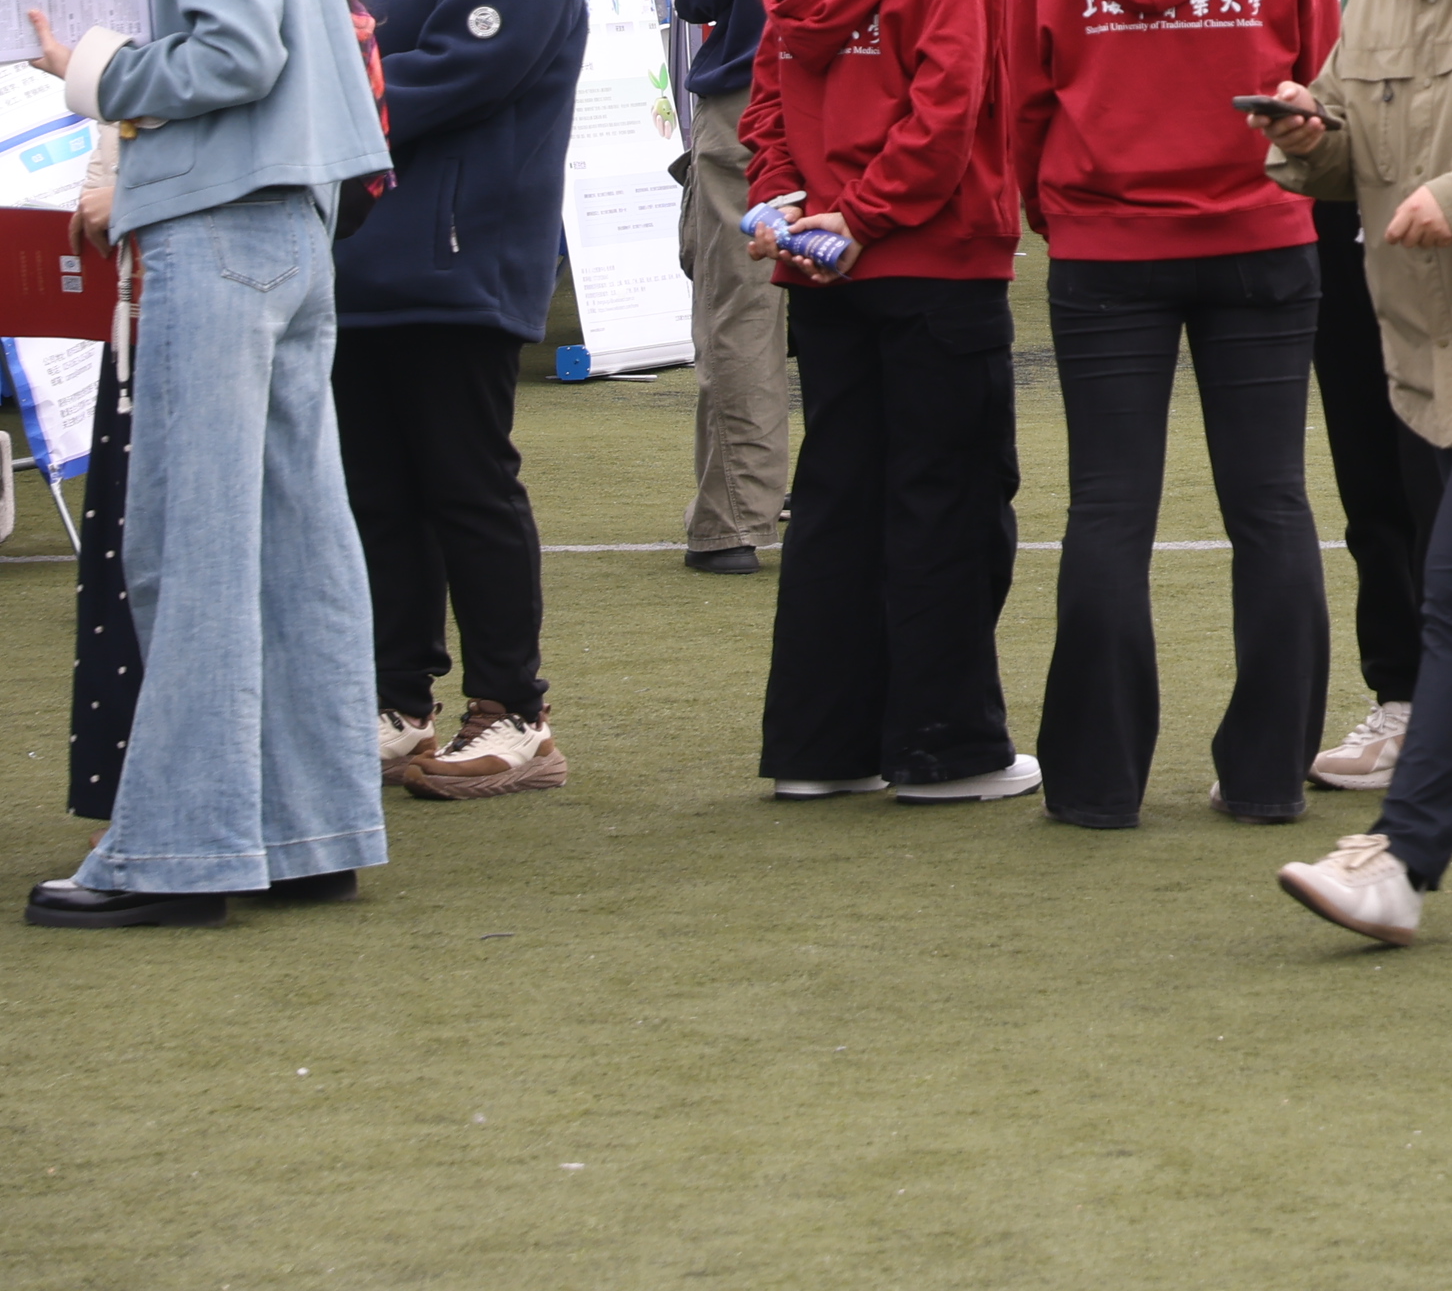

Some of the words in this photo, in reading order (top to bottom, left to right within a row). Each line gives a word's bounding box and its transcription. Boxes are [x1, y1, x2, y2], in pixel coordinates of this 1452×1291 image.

[1110, 21, 1148, 32] University
[1150, 21, 1159, 30] of
[1160, 20, 1203, 30] Traditional
[1204, 18, 1235, 28] Chinese
